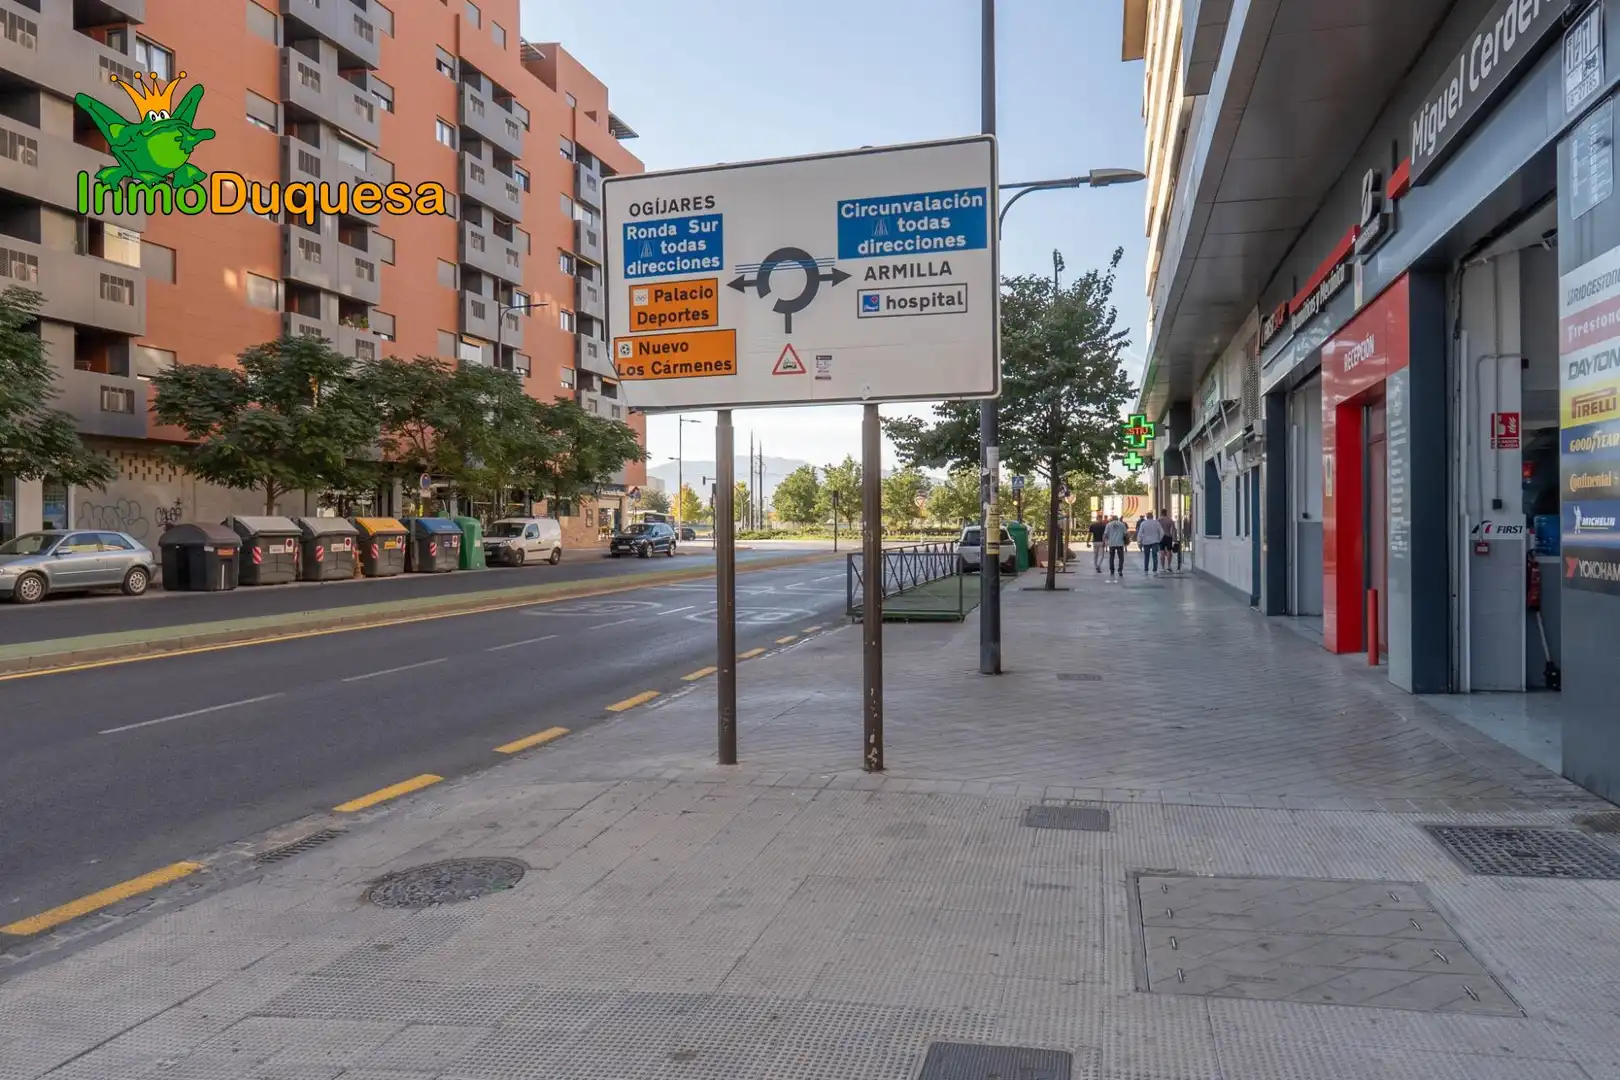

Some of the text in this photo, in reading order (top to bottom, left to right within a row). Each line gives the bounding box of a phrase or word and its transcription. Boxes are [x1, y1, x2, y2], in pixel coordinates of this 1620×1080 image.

[1411, 0, 1552, 166] Miguel Cerde
[629, 195, 716, 217] OGÍJARES
[841, 192, 983, 218] Circunvalación
[626, 219, 719, 241] Ronda Sur
[897, 216, 951, 233] todas
[660, 239, 707, 255] todas
[857, 234, 967, 255] direcciones
[627, 256, 720, 275] direcciones
[864, 260, 953, 281] ARMILLA
[654, 286, 713, 303] Palacio
[886, 290, 964, 311] hospital
[637, 308, 710, 326] Deportes
[638, 341, 689, 355] Nuevo
[617, 359, 732, 376] Los Cármenes
[1568, 346, 1620, 380] DAYTON
[1571, 387, 1617, 419] PIRELLI
[1569, 431, 1619, 453] GOODYEAR
[1569, 471, 1612, 492] Continental
[1581, 516, 1616, 527] MICHELIN
